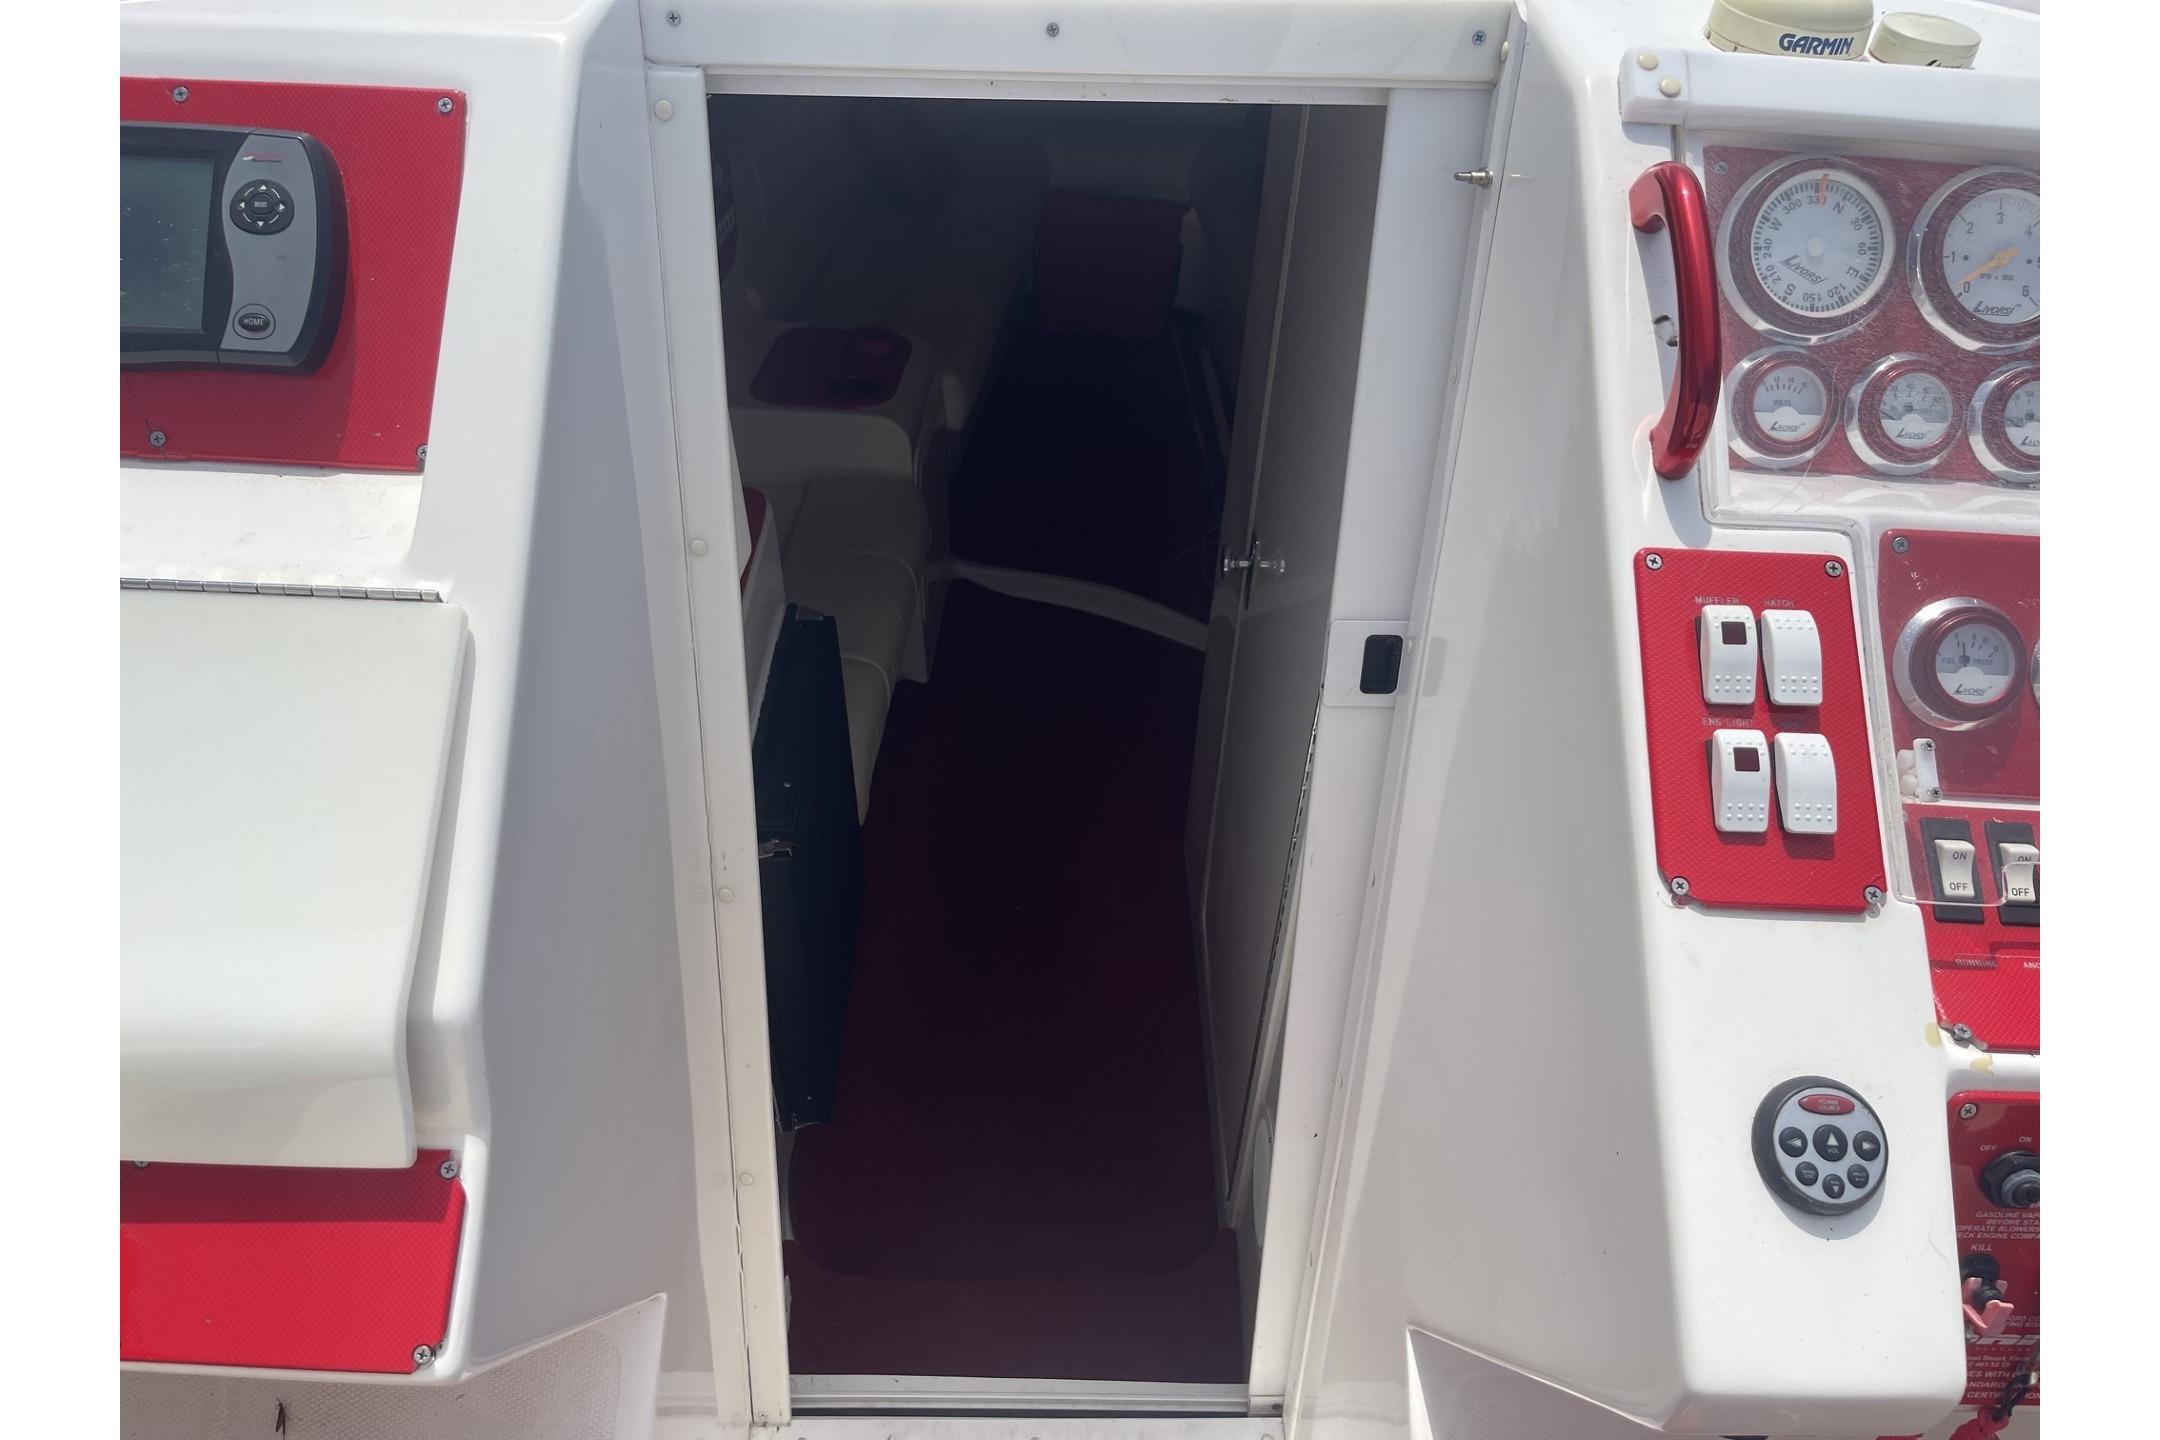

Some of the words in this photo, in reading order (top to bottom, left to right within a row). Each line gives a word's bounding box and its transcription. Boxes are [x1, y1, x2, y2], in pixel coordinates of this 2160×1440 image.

[1778, 32, 1854, 56] GARMIN
[1782, 198, 1802, 215] 300
[1832, 201, 1844, 214] N
[1768, 217, 1783, 231] W
[1850, 217, 1863, 231] 30
[1997, 212, 2004, 225] 3
[1966, 222, 1974, 234] 2
[2024, 225, 2032, 237] 4
[1763, 238, 1773, 258] 240
[1857, 242, 1866, 256] 60
[1765, 264, 1781, 285] 210
[1846, 266, 1860, 278] E
[1784, 283, 1796, 296] S
[1827, 283, 1847, 298] 120
[1963, 281, 1970, 294] 0
[2022, 285, 2029, 297] 6
[1802, 292, 1822, 303] 150
[243, 317, 265, 326] HOME
[1695, 595, 1740, 604] MUFFLER
[1764, 599, 1794, 608] HATCH
[1952, 850, 1967, 860] ON
[2017, 855, 2032, 864] ON
[1949, 882, 1968, 892] OFF
[2011, 887, 2029, 897] OFF
[1976, 1211, 2020, 1219] GASOLINE
[1970, 1243, 1993, 1251] KILL
